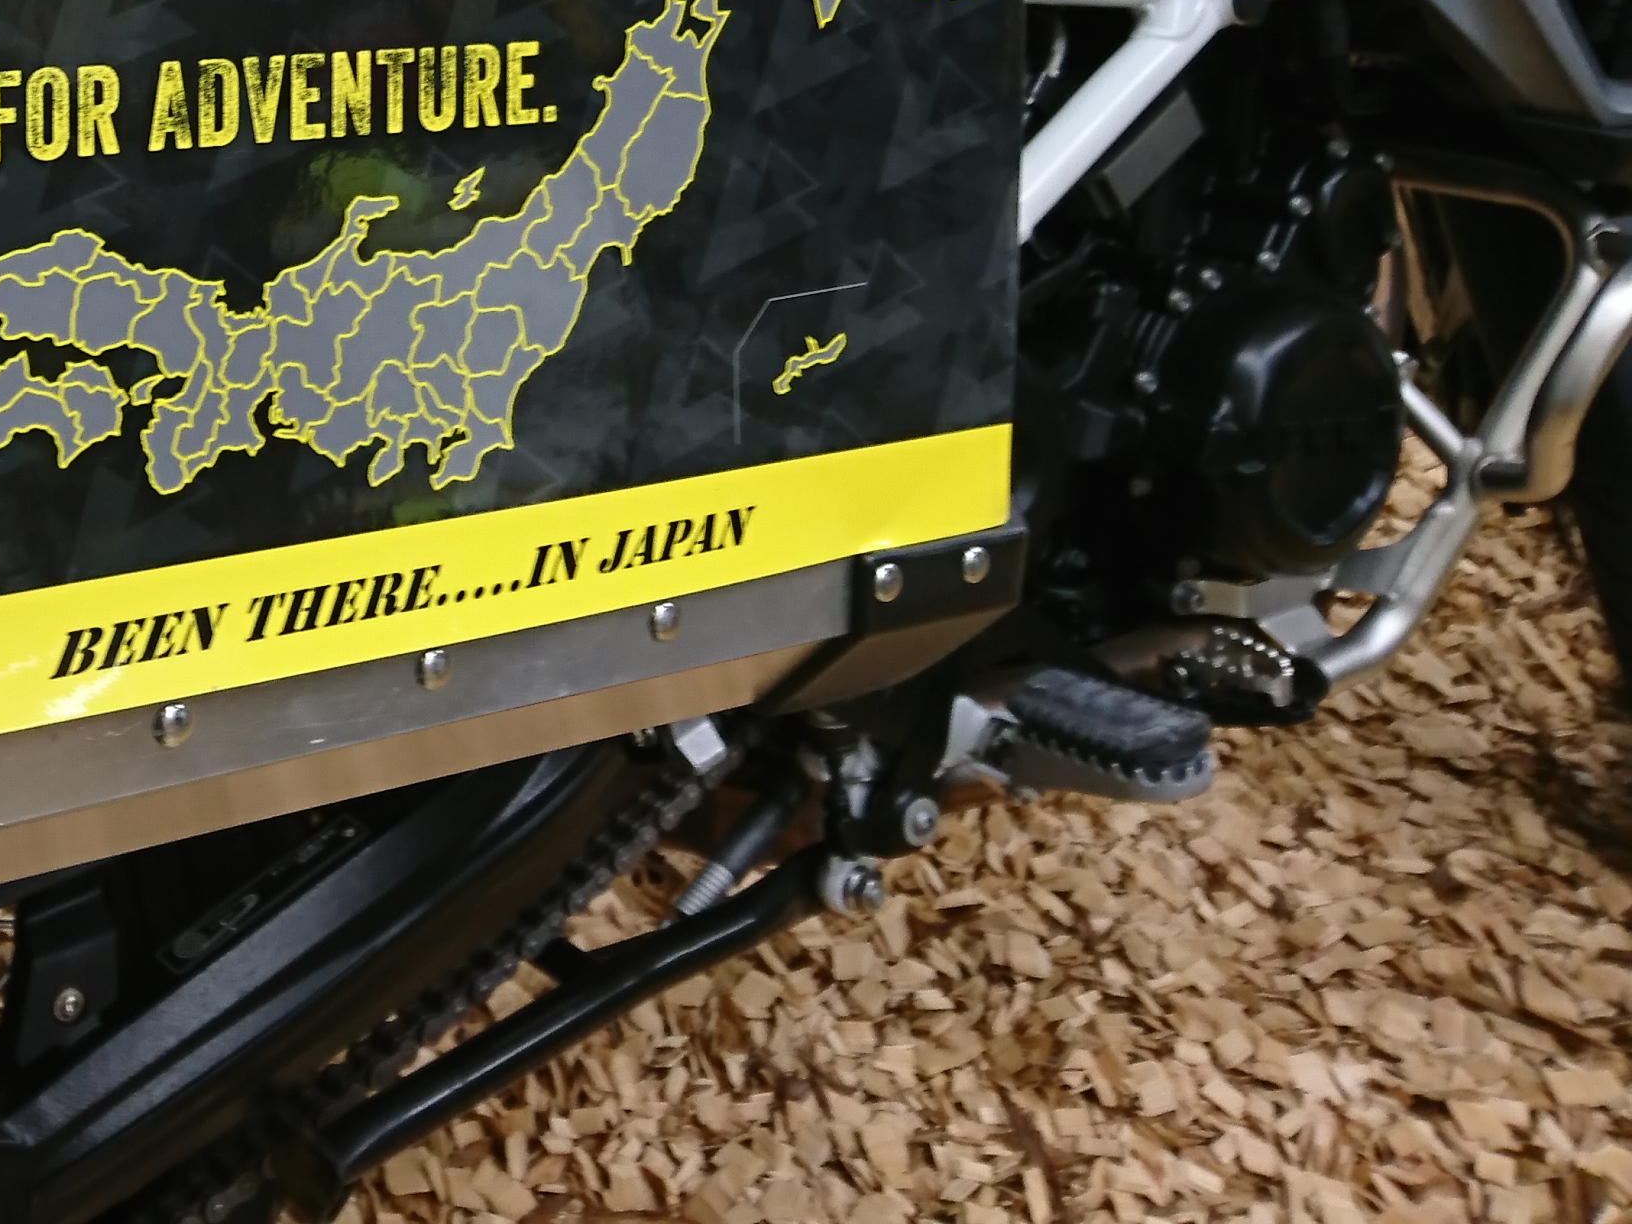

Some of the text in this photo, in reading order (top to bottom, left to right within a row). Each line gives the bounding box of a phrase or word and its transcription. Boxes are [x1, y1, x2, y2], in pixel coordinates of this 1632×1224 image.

[148, 41, 558, 152] ADVENTURE.
[49, 603, 230, 679] BEEN
[599, 507, 756, 574] JAPAN
